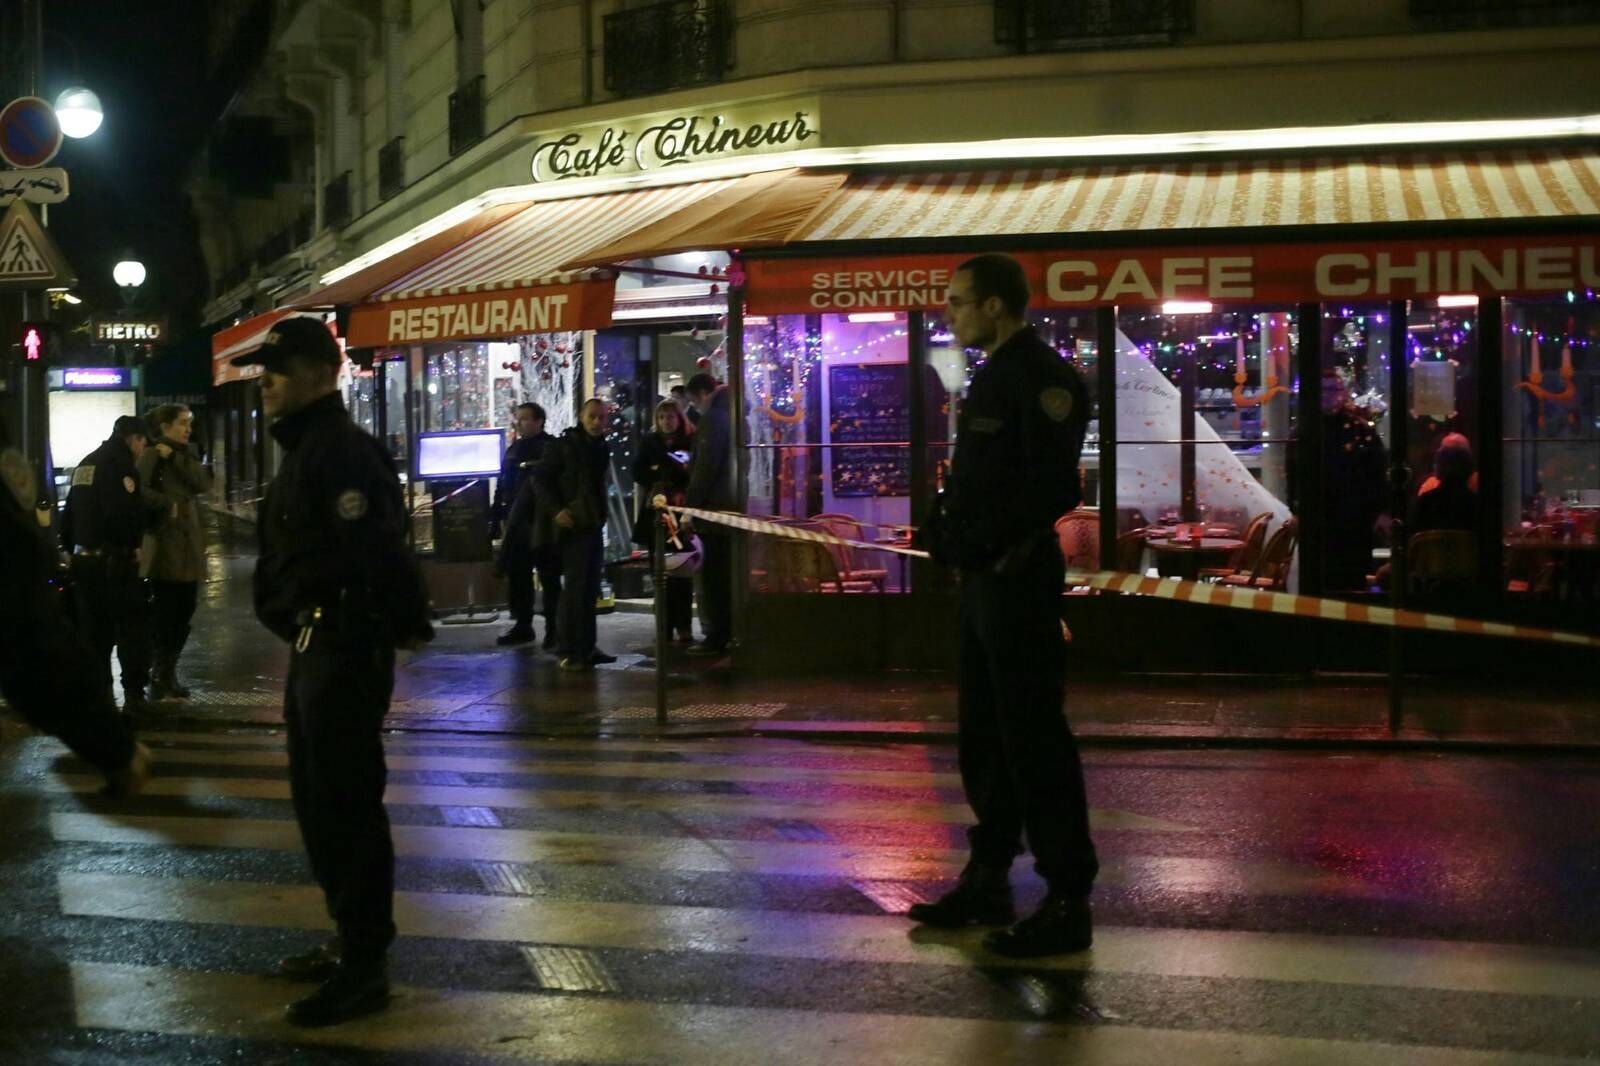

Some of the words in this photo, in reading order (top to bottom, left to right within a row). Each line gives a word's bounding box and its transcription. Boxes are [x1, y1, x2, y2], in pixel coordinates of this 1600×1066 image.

[532, 127, 629, 183] Café
[636, 111, 817, 170] Chineur
[810, 268, 950, 290] SERVICE
[1045, 255, 1255, 303] CAFE
[98, 322, 160, 339] METRO
[387, 293, 568, 342] RESTAURANT
